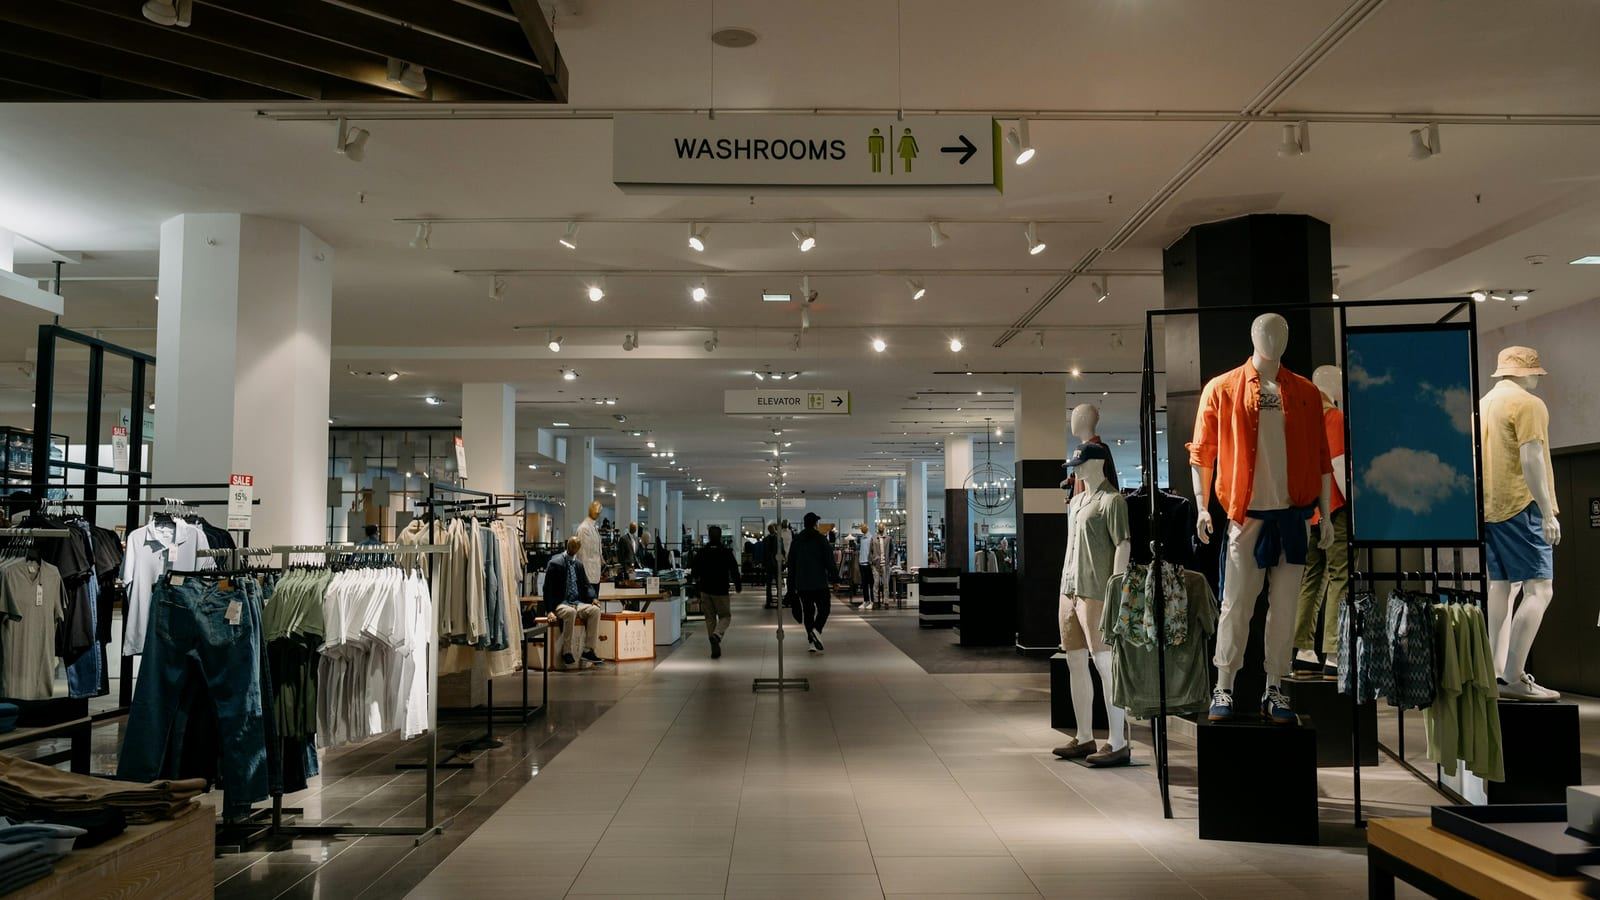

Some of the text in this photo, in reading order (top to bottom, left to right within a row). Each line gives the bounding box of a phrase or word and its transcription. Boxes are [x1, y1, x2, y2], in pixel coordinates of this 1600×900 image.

[674, 138, 847, 161] WASHROOMS
[757, 397, 801, 406] ELEVATOR
[232, 475, 251, 486] SALE
[234, 492, 248, 501] 15%
